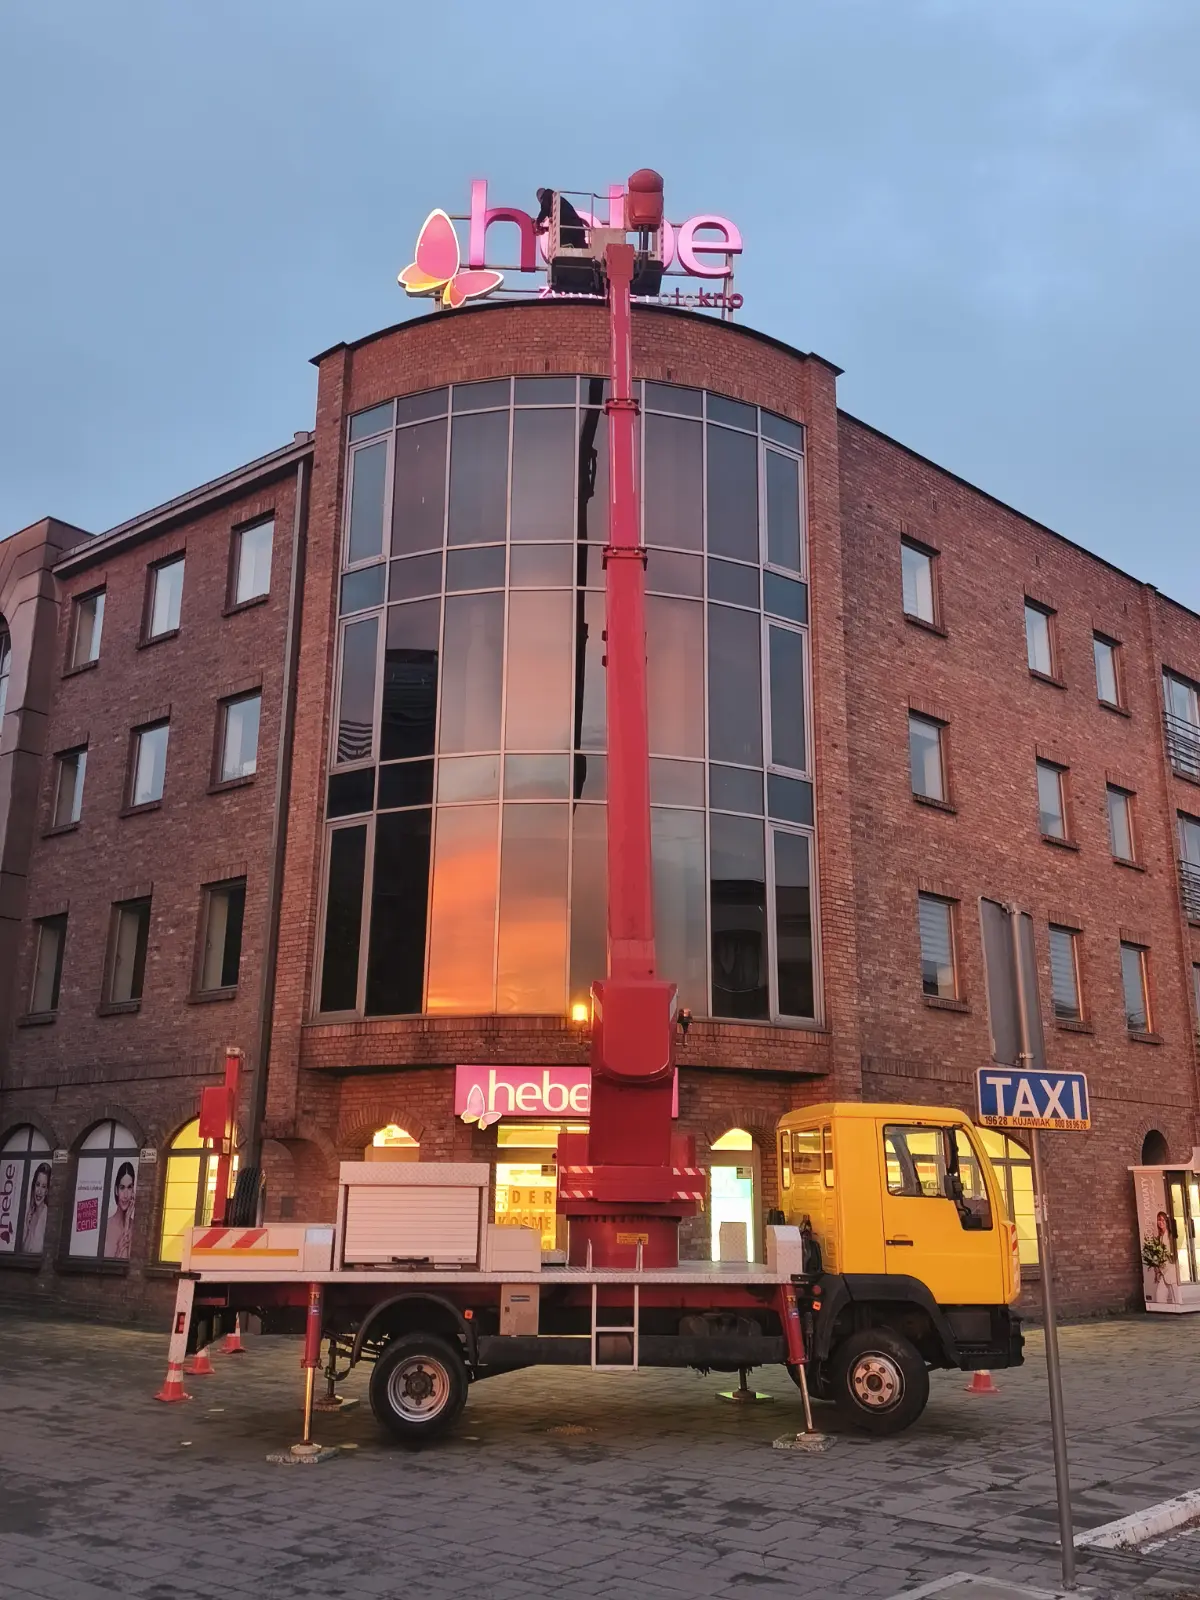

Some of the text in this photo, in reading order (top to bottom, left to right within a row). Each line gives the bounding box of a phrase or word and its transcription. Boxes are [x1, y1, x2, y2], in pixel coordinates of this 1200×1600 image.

[488, 1069, 590, 1112] hebe
[986, 1076, 1082, 1120] TAXI
[985, 1116, 997, 1126] 196
[998, 1116, 1008, 1126] 28
[1012, 1117, 1051, 1127] KUJAWIAK
